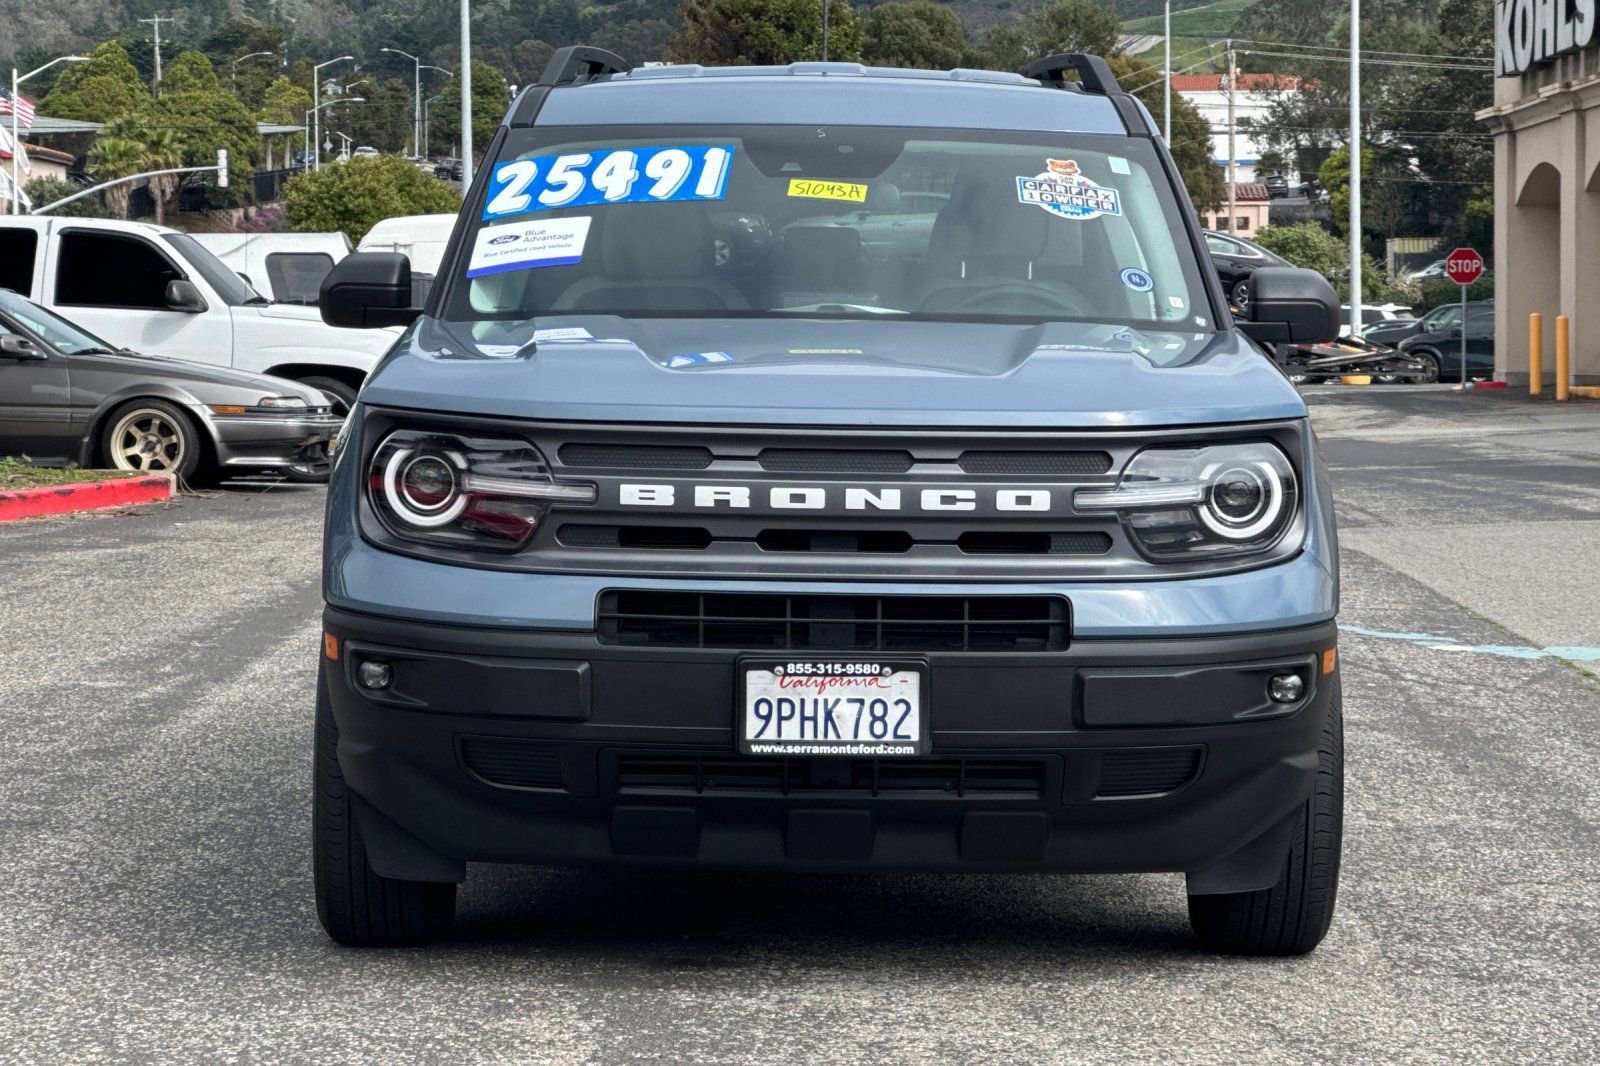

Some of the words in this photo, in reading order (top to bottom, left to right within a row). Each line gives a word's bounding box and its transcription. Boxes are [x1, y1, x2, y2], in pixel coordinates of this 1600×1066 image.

[486, 147, 731, 214] 25491
[1024, 181, 1111, 201] CARFAX
[1041, 193, 1114, 211] OWNER
[523, 233, 574, 243] Advantage
[500, 247, 527, 255] Certified
[1449, 259, 1480, 273] STOP
[619, 484, 1051, 511] BRONCO
[786, 663, 880, 674] 855-315-9580
[779, 676, 891, 695] California
[753, 697, 912, 740] 9PHK782
[751, 744, 914, 755] www.serramonteford.com
